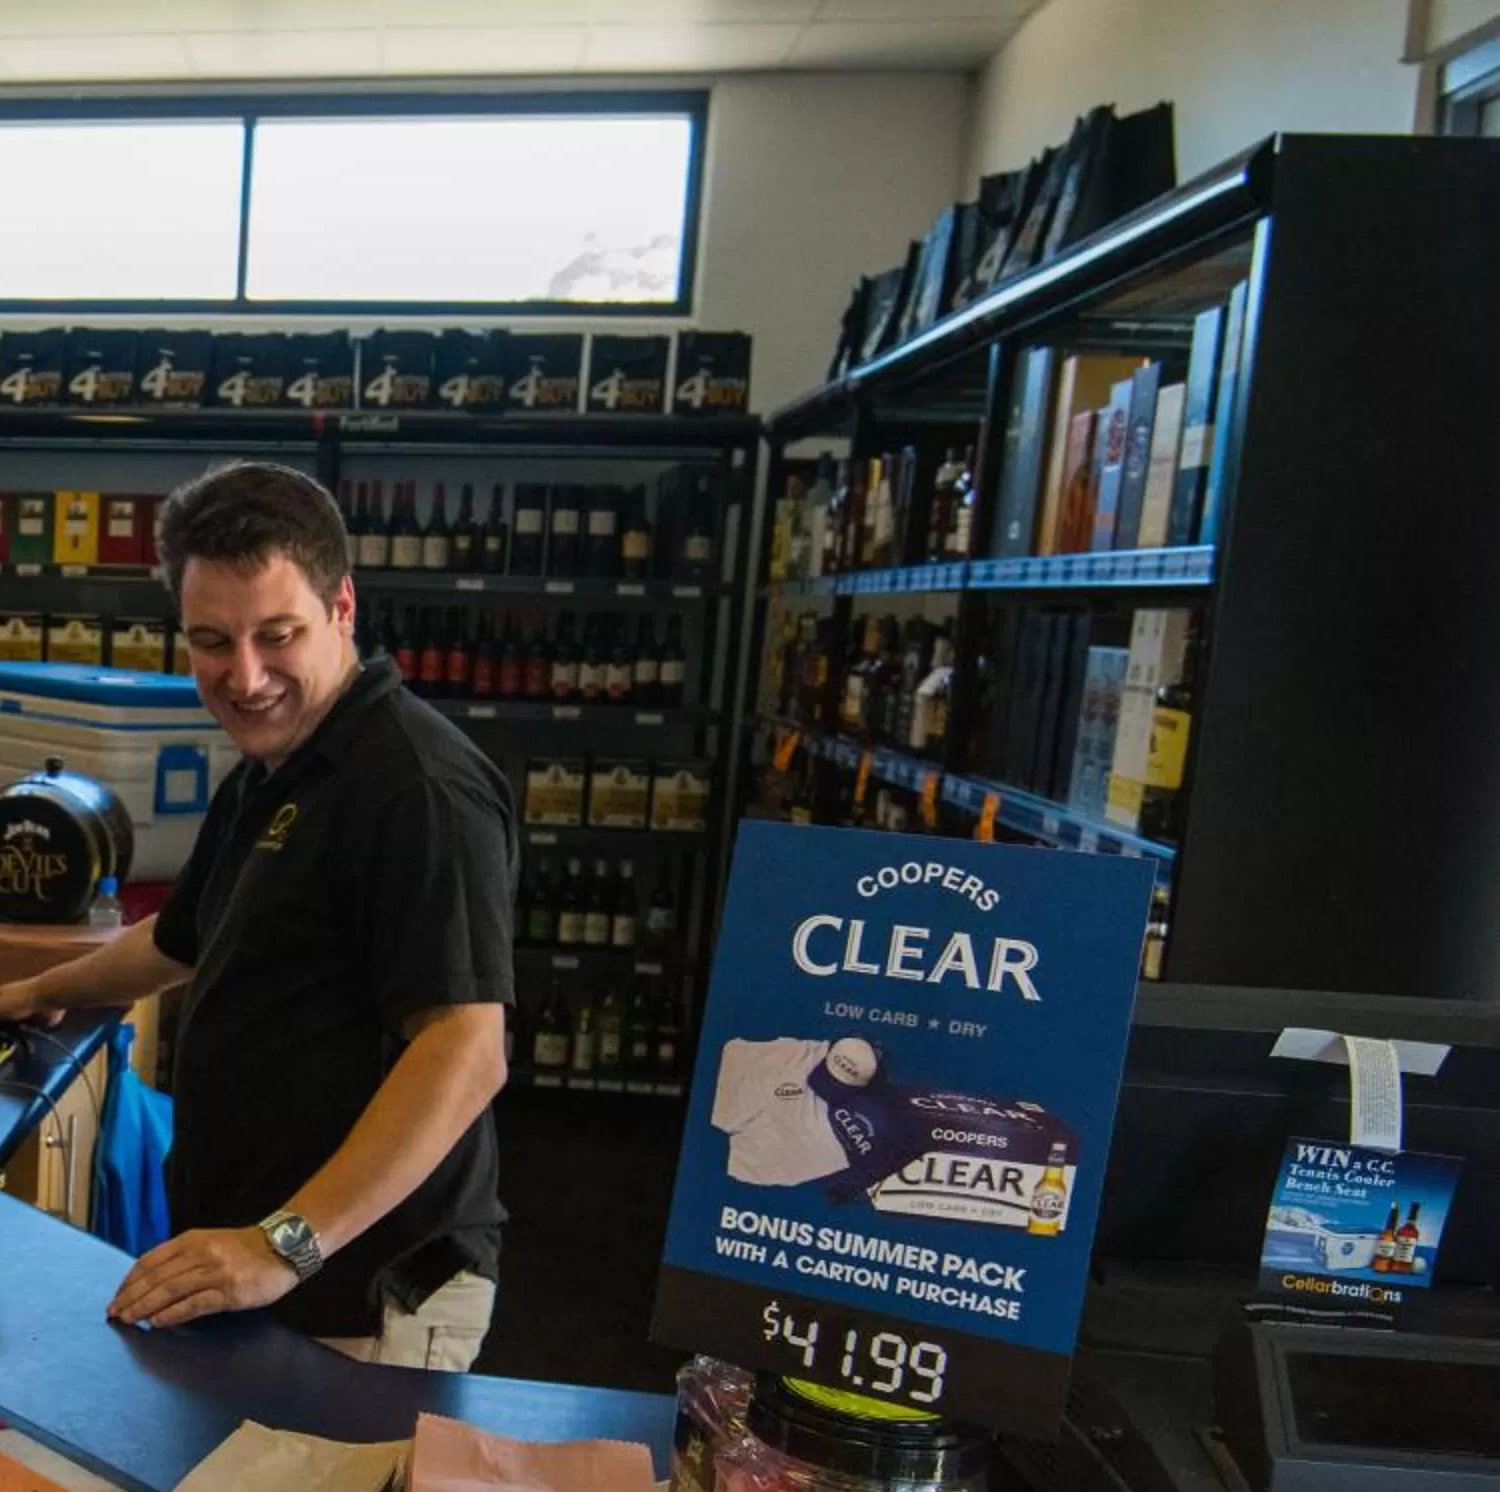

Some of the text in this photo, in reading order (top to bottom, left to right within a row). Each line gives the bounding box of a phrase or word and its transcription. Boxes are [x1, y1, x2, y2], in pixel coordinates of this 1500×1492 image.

[856, 861, 1000, 911] COOPERS
[791, 913, 1043, 1001] CLEAR
[825, 1001, 988, 1038] LOW CARB DRY
[834, 1109, 873, 1156] CLEAR
[931, 1127, 1009, 1149] COOPERS
[1289, 1163, 1397, 1188] Tennis Cooler
[1296, 1143, 1352, 1169] WIN
[898, 1157, 1024, 1197] CLEAR
[1284, 1176, 1333, 1194] Bench
[1333, 1183, 1368, 1200] Seat
[720, 1205, 1028, 1293] BONUS SUMMER PACK
[715, 1236, 1022, 1322] WITH A CARTON PURCHASE
[1281, 1274, 1402, 1304] Cellarbrations
[762, 1300, 948, 1403] $41.99
